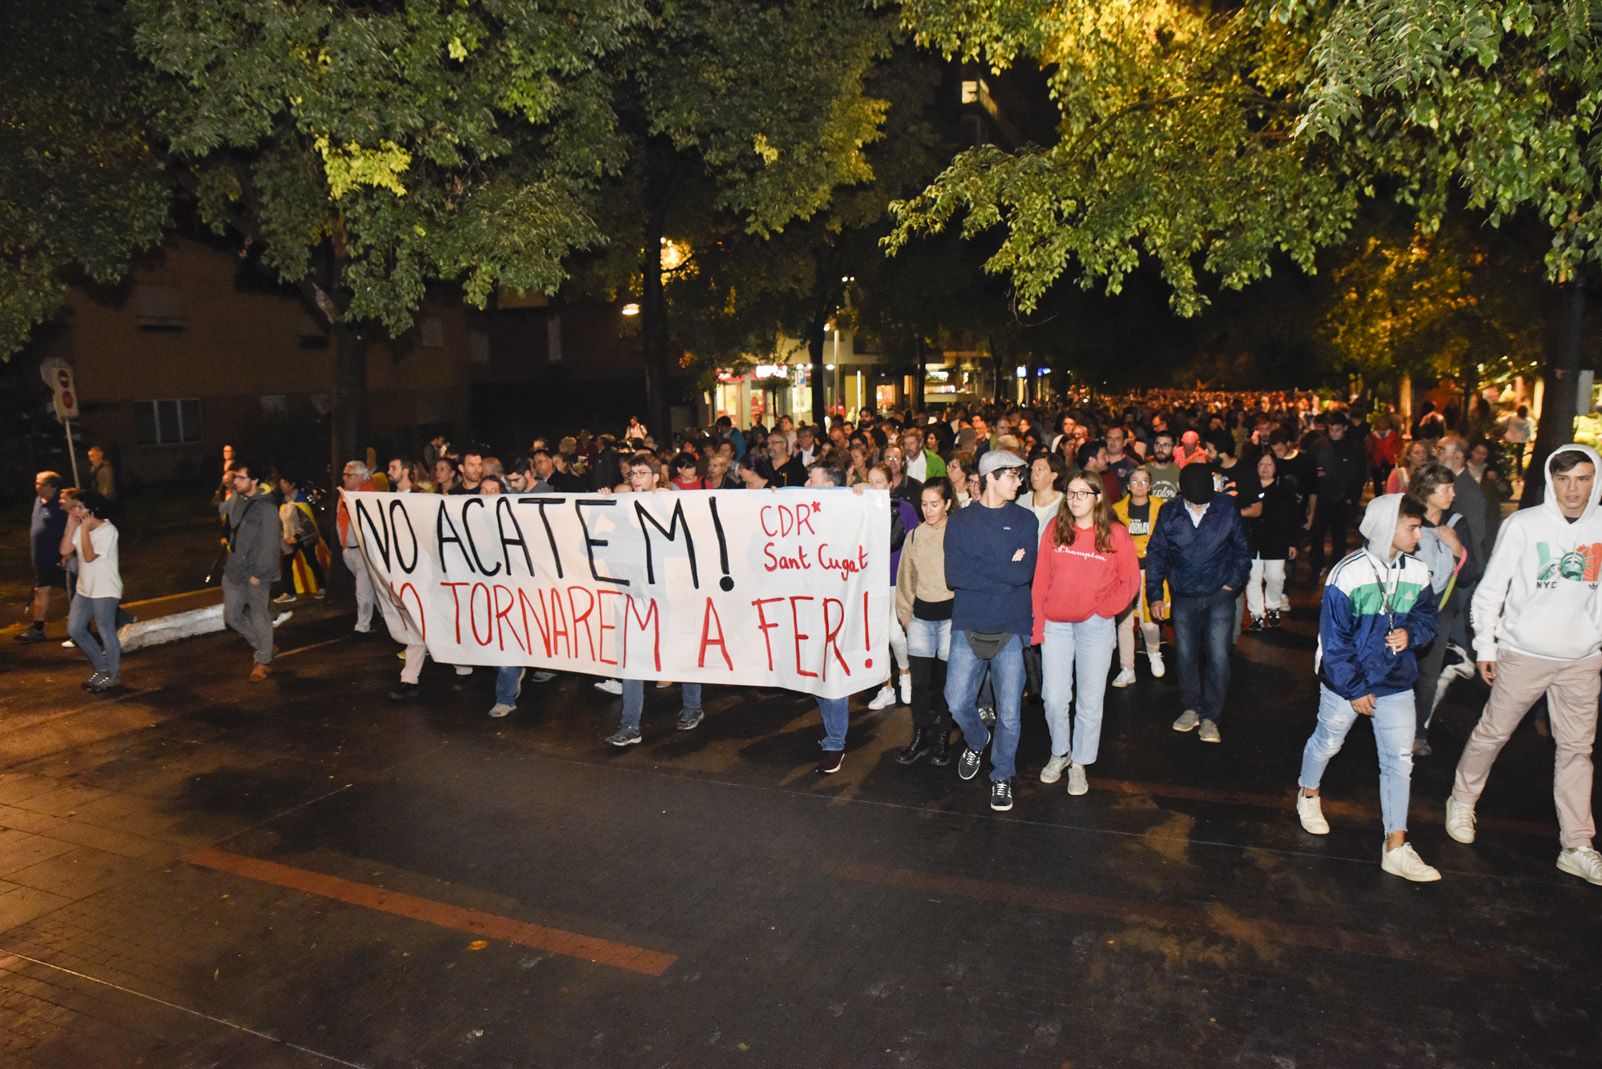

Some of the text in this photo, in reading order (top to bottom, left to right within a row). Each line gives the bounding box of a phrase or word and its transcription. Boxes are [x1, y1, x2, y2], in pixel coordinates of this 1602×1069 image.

[355, 496, 735, 592] NO ACATEM!
[764, 542, 869, 581] Sant Cugat
[1054, 544, 1106, 561] Champion
[1536, 581, 1558, 589] NYC
[440, 581, 662, 672] TORNAREM
[698, 596, 734, 671] A
